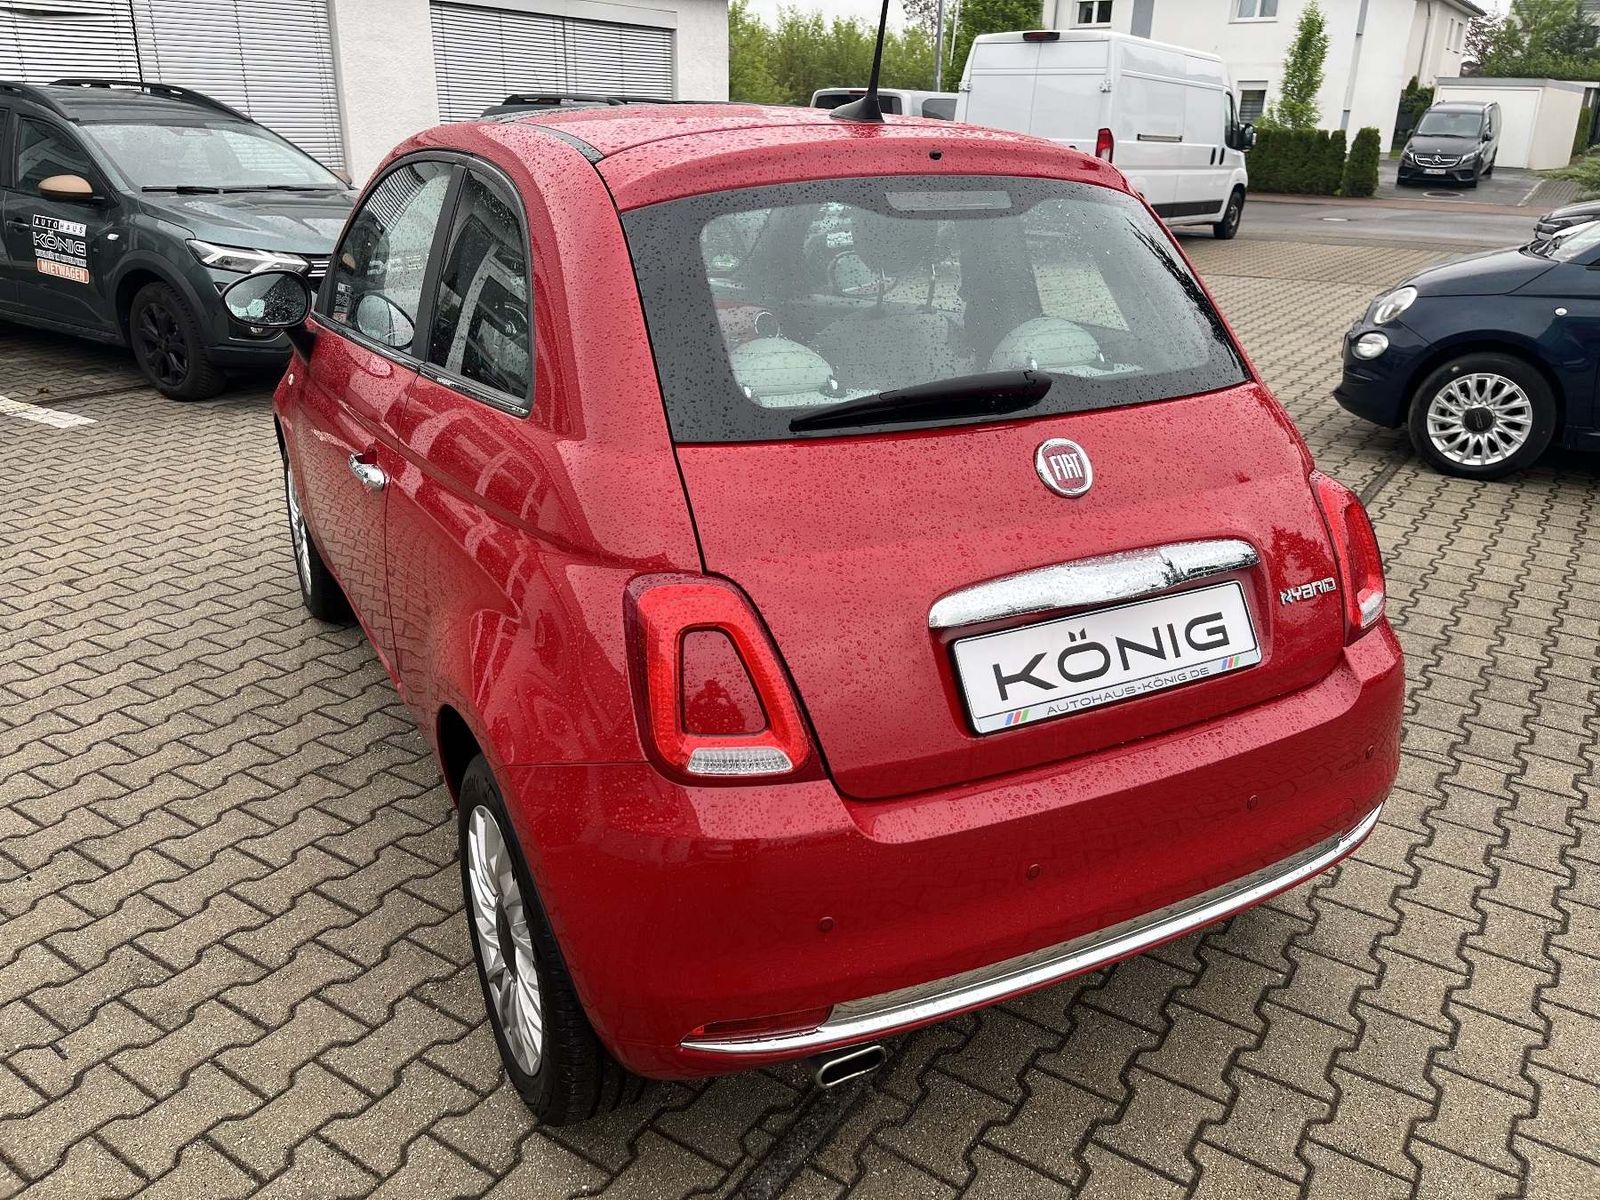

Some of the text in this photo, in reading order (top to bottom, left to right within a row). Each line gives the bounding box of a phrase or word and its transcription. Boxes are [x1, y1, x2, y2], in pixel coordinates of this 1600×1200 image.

[33, 230, 86, 257] KÖNIG
[41, 260, 86, 282] MIETWAGEN
[1048, 453, 1083, 481] FIAT
[1279, 577, 1337, 605] HYBRID
[993, 612, 1230, 701] KÖNIG
[1046, 667, 1210, 715] AUTOHAUS-KÖNIG.DE
